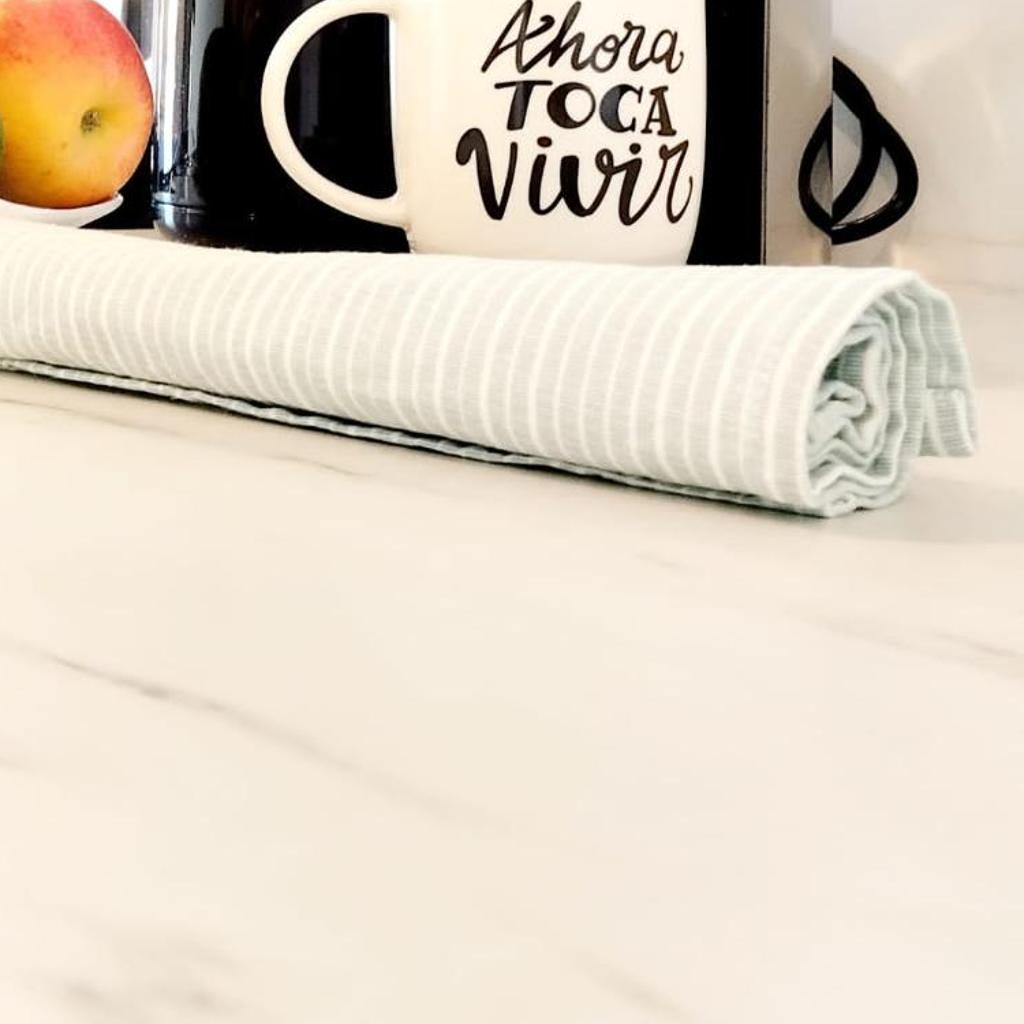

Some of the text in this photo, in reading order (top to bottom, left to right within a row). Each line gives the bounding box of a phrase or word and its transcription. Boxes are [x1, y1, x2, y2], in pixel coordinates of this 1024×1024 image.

[480, 0, 684, 74] Ahora
[494, 80, 677, 136] TOCA
[456, 128, 693, 226] Vivir
